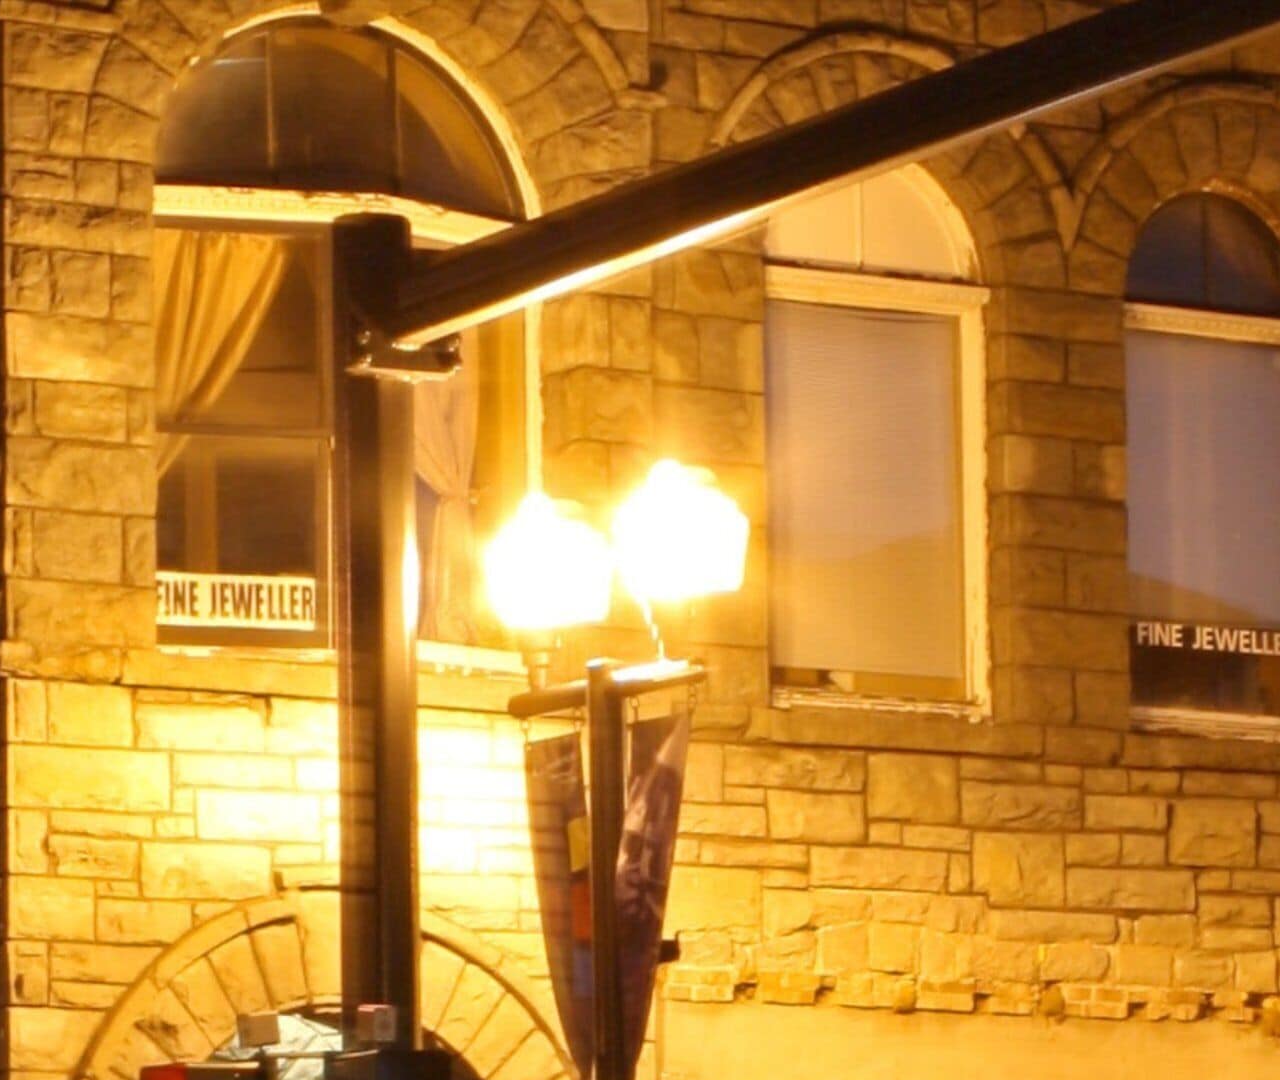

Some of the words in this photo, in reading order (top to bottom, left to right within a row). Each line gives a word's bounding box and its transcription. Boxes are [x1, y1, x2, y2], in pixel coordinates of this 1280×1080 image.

[156, 579, 199, 617] FINE
[210, 581, 315, 621] JEWELLER
[1136, 621, 1183, 648] FINE
